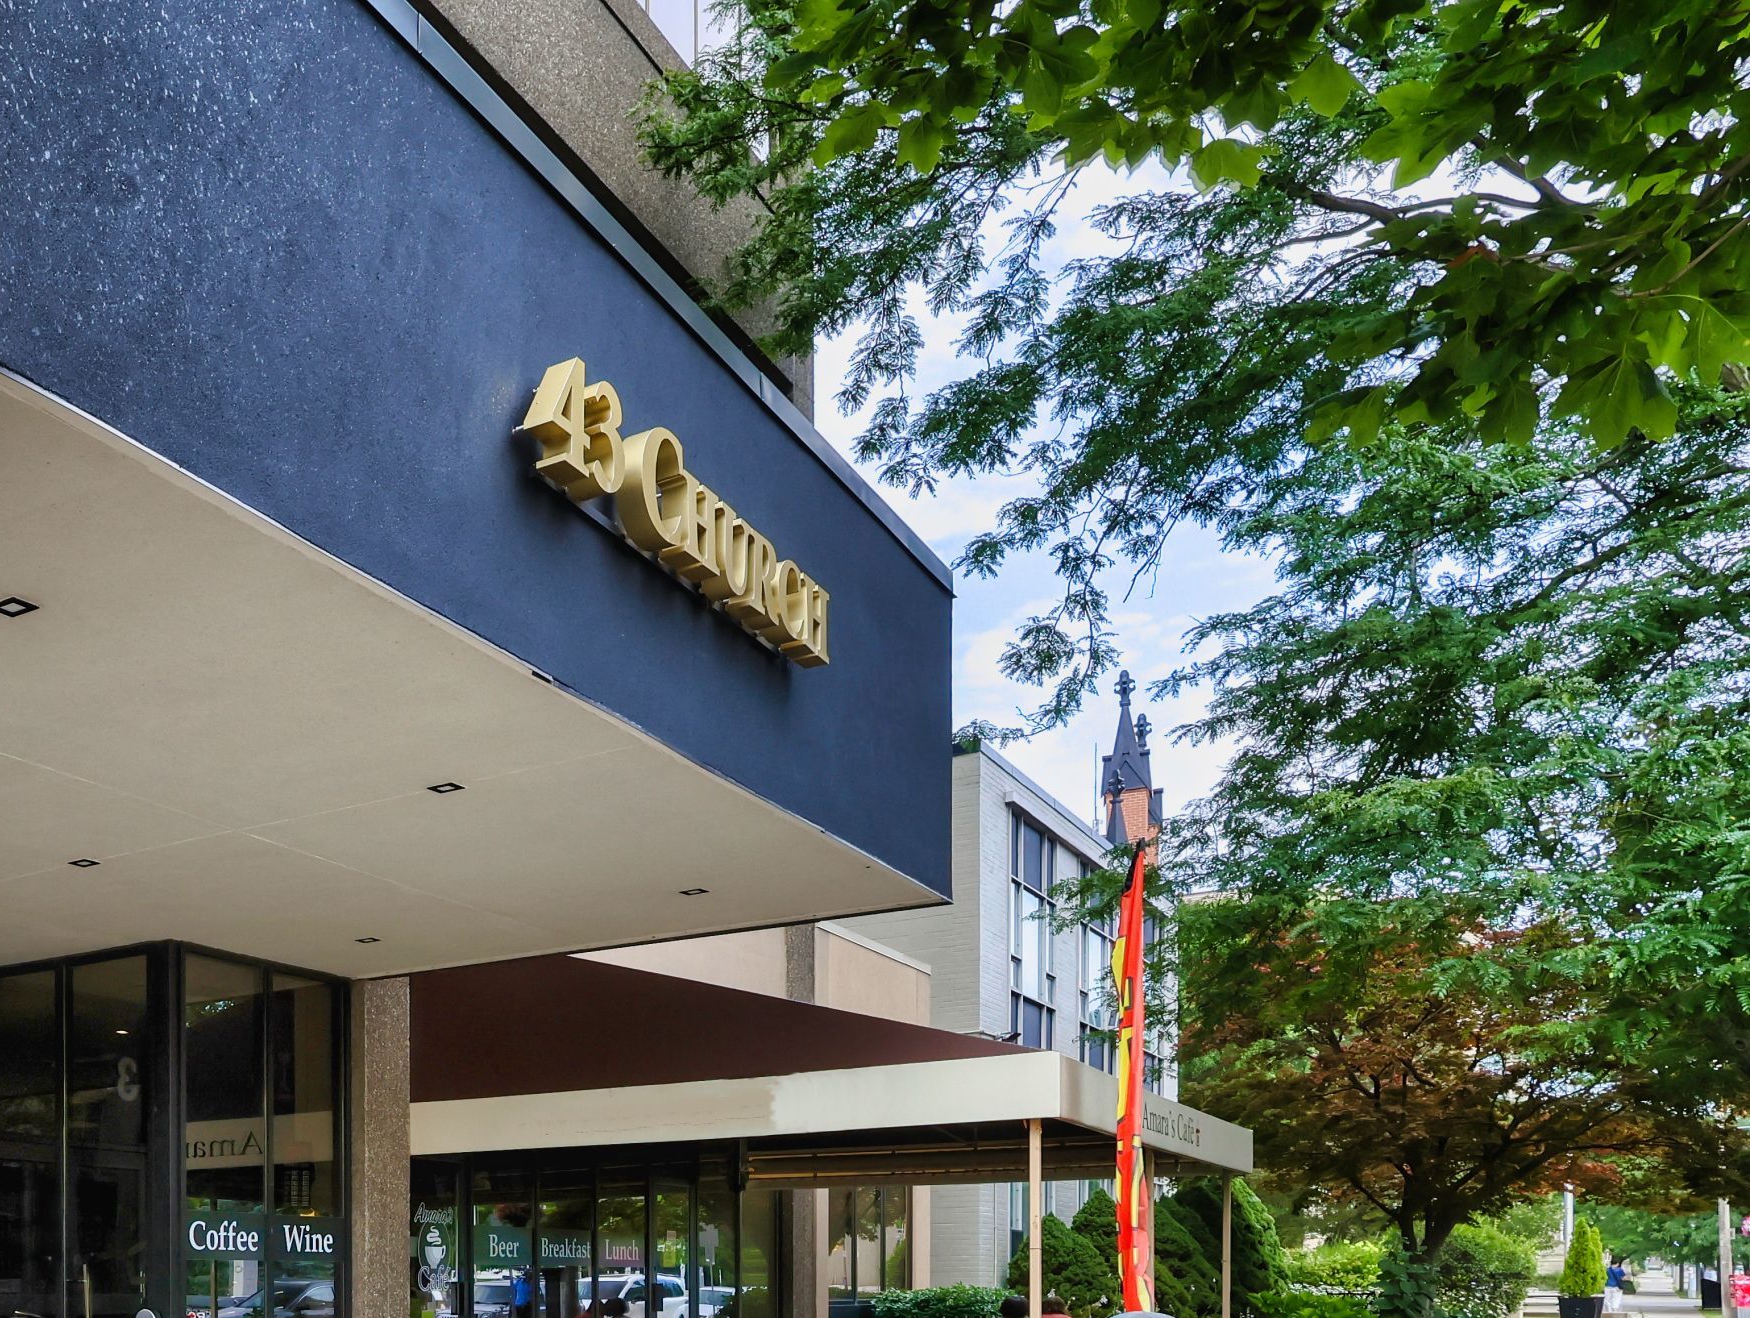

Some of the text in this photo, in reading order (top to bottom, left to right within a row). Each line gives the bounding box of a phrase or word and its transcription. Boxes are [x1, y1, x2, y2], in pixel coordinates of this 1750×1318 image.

[523, 357, 830, 668] 43 CHURCH
[1142, 1101, 1176, 1139] Amara's
[188, 1220, 334, 1253] Coffee Wine
[488, 1234, 639, 1261] Beer Breakfast Lunch
